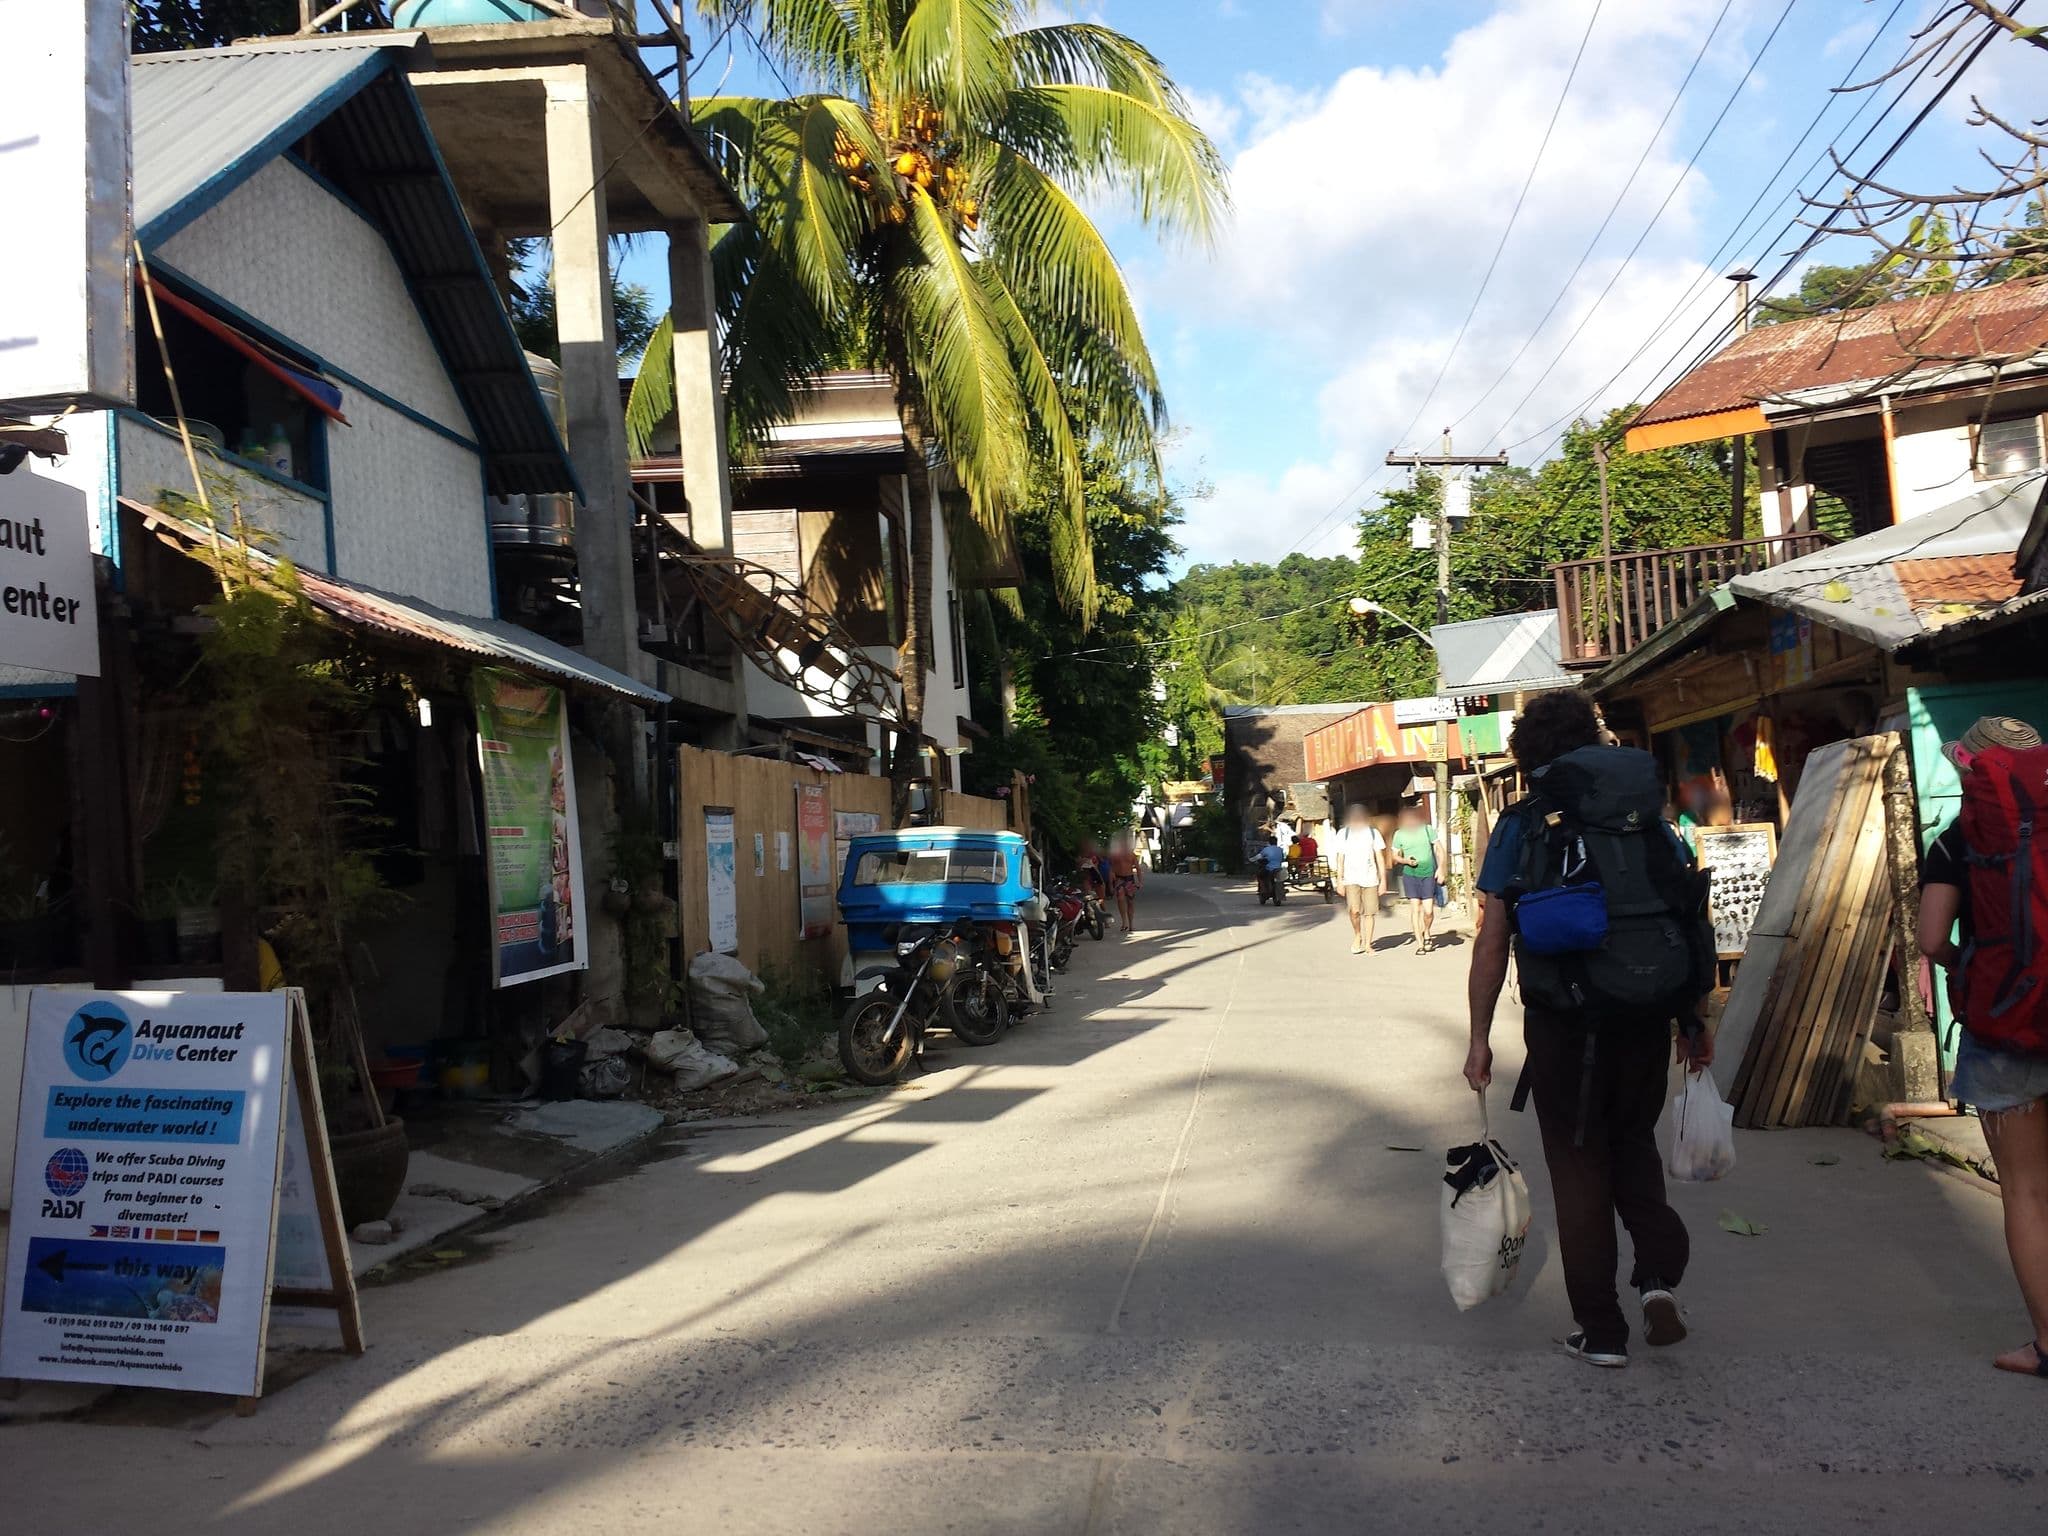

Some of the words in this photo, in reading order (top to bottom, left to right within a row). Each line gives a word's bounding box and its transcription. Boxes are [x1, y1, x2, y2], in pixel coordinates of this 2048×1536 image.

[3, 582, 80, 625] enter
[134, 1019, 245, 1041] Aquanaut
[131, 1044, 174, 1061] Dive
[176, 1045, 238, 1062] Center
[54, 1091, 112, 1110] Explore
[115, 1093, 141, 1110] the
[144, 1095, 233, 1116] fascinating
[67, 1118, 160, 1135] underwater
[162, 1120, 206, 1136] world
[95, 1152, 115, 1164] We
[116, 1153, 147, 1166] offer
[149, 1154, 185, 1167] Scuba
[187, 1156, 226, 1171] Diving
[92, 1171, 119, 1185] trips
[121, 1172, 144, 1184] and
[147, 1173, 177, 1185] PADI
[180, 1176, 224, 1187] courses
[103, 1188, 133, 1203] from
[135, 1190, 188, 1206] beginner
[191, 1192, 203, 1205] to
[41, 1199, 86, 1219] PADI
[117, 1209, 189, 1223] divemaster!
[114, 1256, 151, 1277] this
[156, 1264, 200, 1285] way
